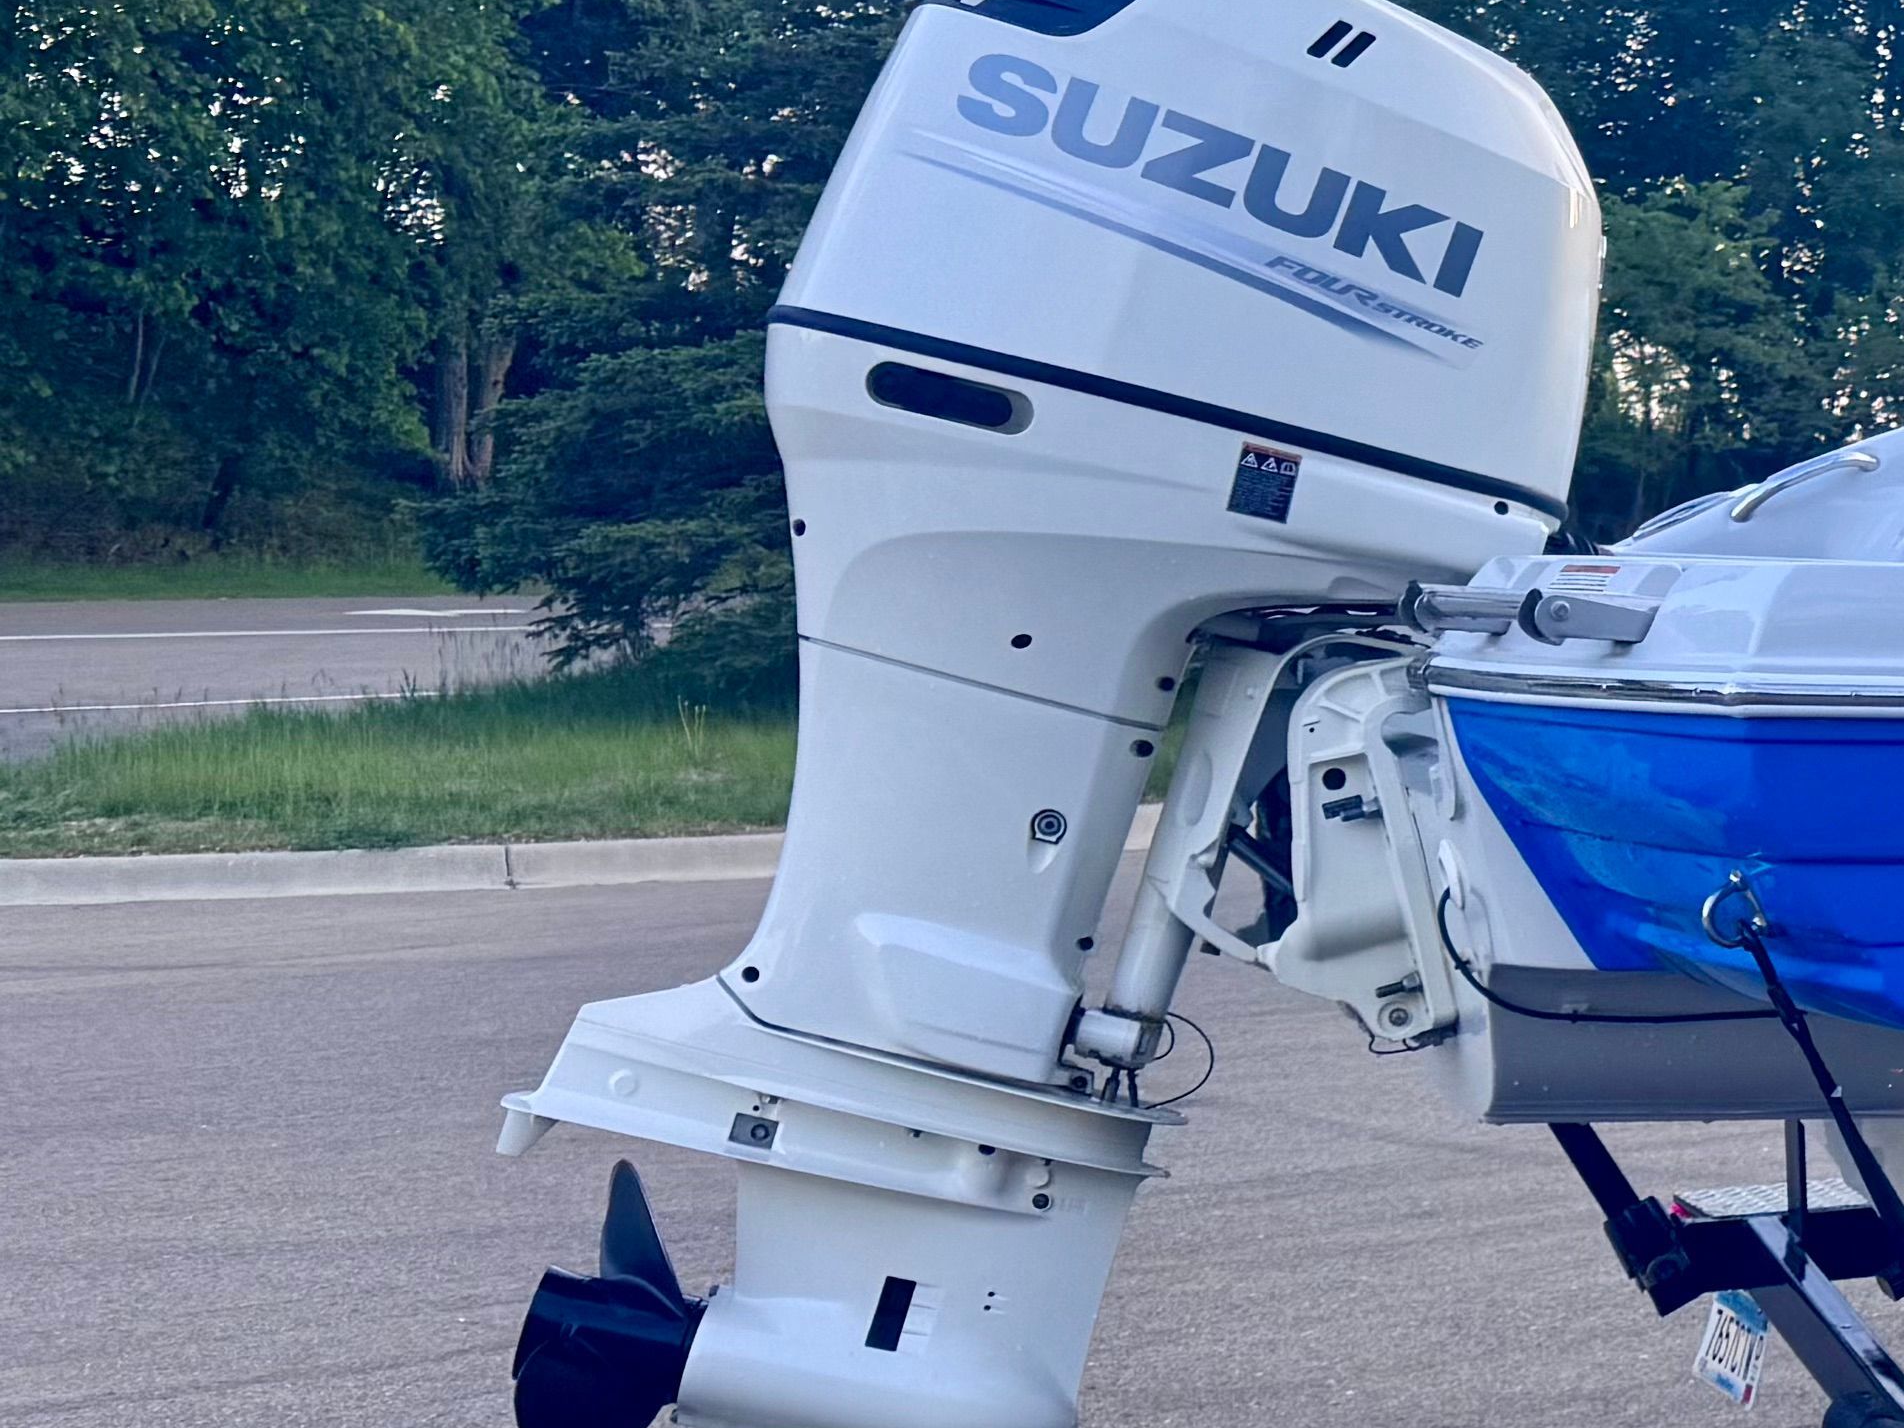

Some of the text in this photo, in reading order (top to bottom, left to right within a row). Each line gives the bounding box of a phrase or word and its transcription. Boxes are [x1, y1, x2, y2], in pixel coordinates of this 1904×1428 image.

[957, 53, 1484, 298] SUZUKI
[1264, 255, 1485, 350] FOUR STROKE
